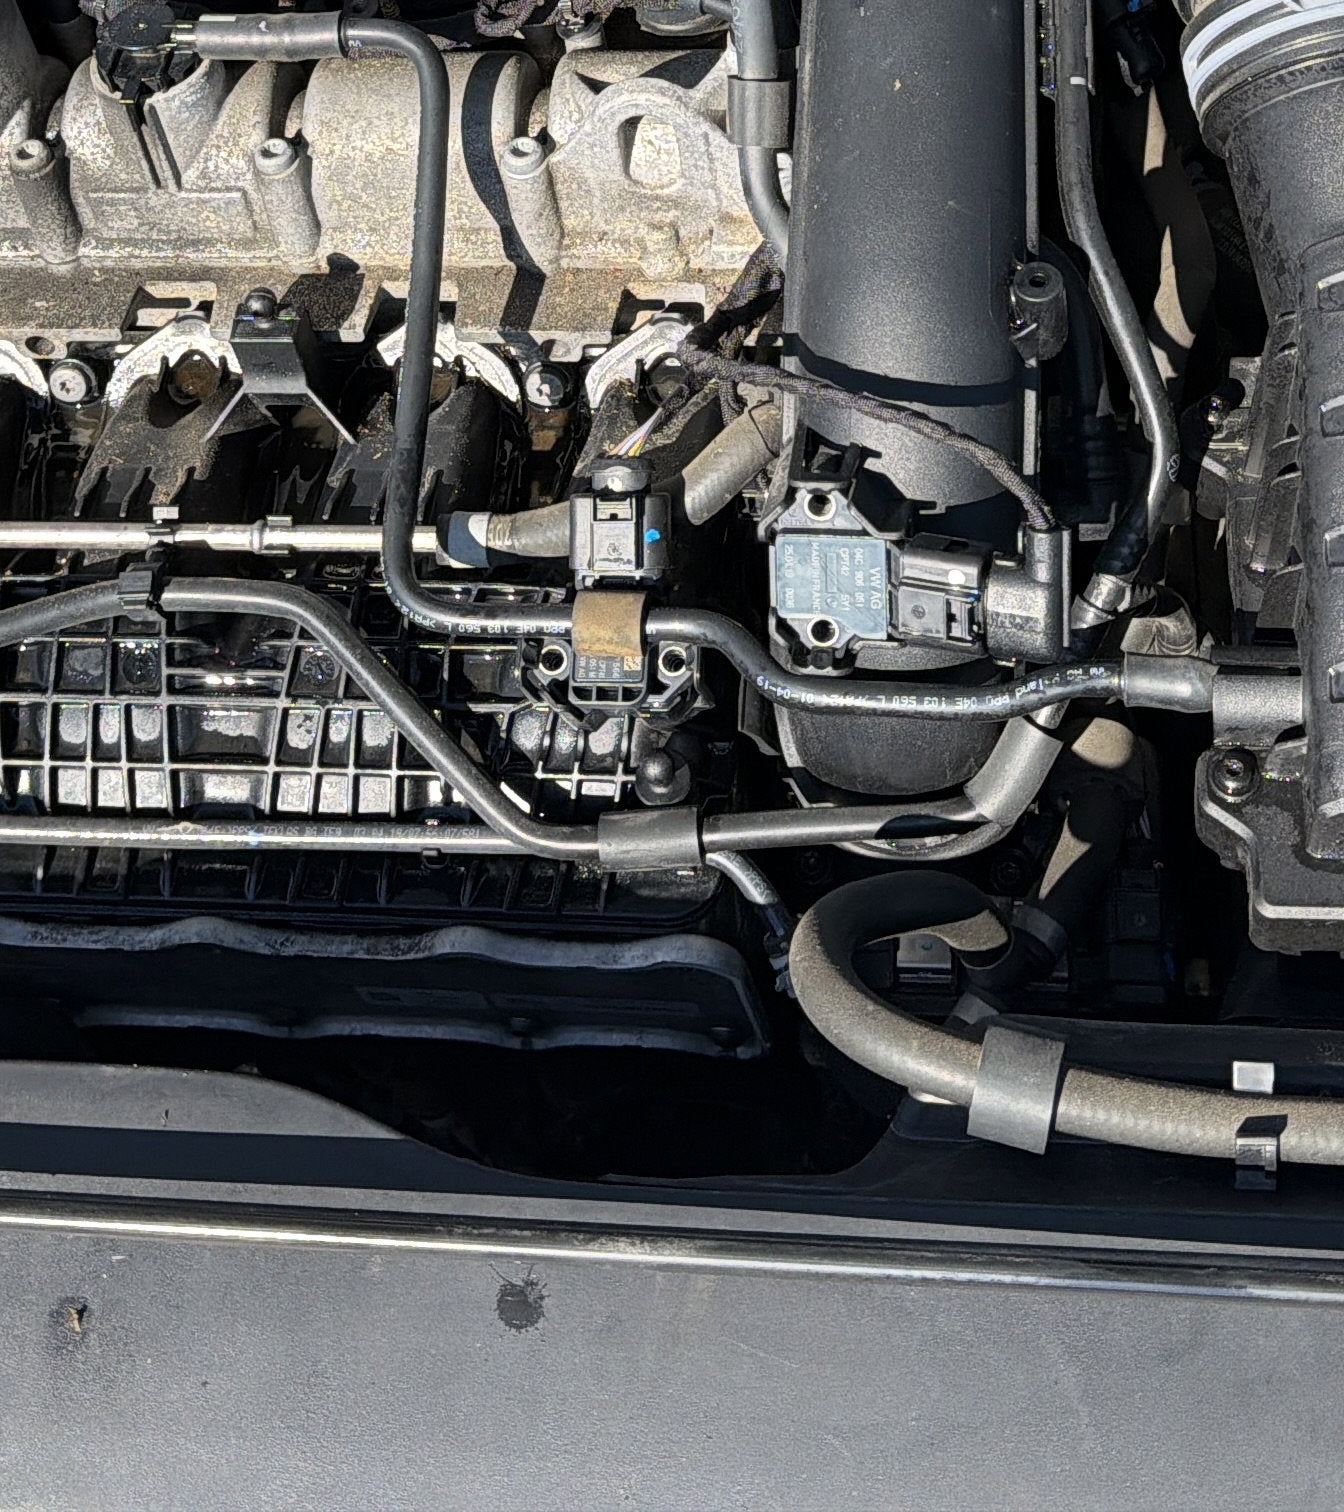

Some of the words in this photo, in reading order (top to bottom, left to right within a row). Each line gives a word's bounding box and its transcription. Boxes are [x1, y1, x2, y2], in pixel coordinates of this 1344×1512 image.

[867, 567, 881, 589] VW
[868, 590, 882, 610] AG
[457, 622, 480, 632] 560
[486, 622, 508, 631] 103
[890, 694, 917, 706] 560
